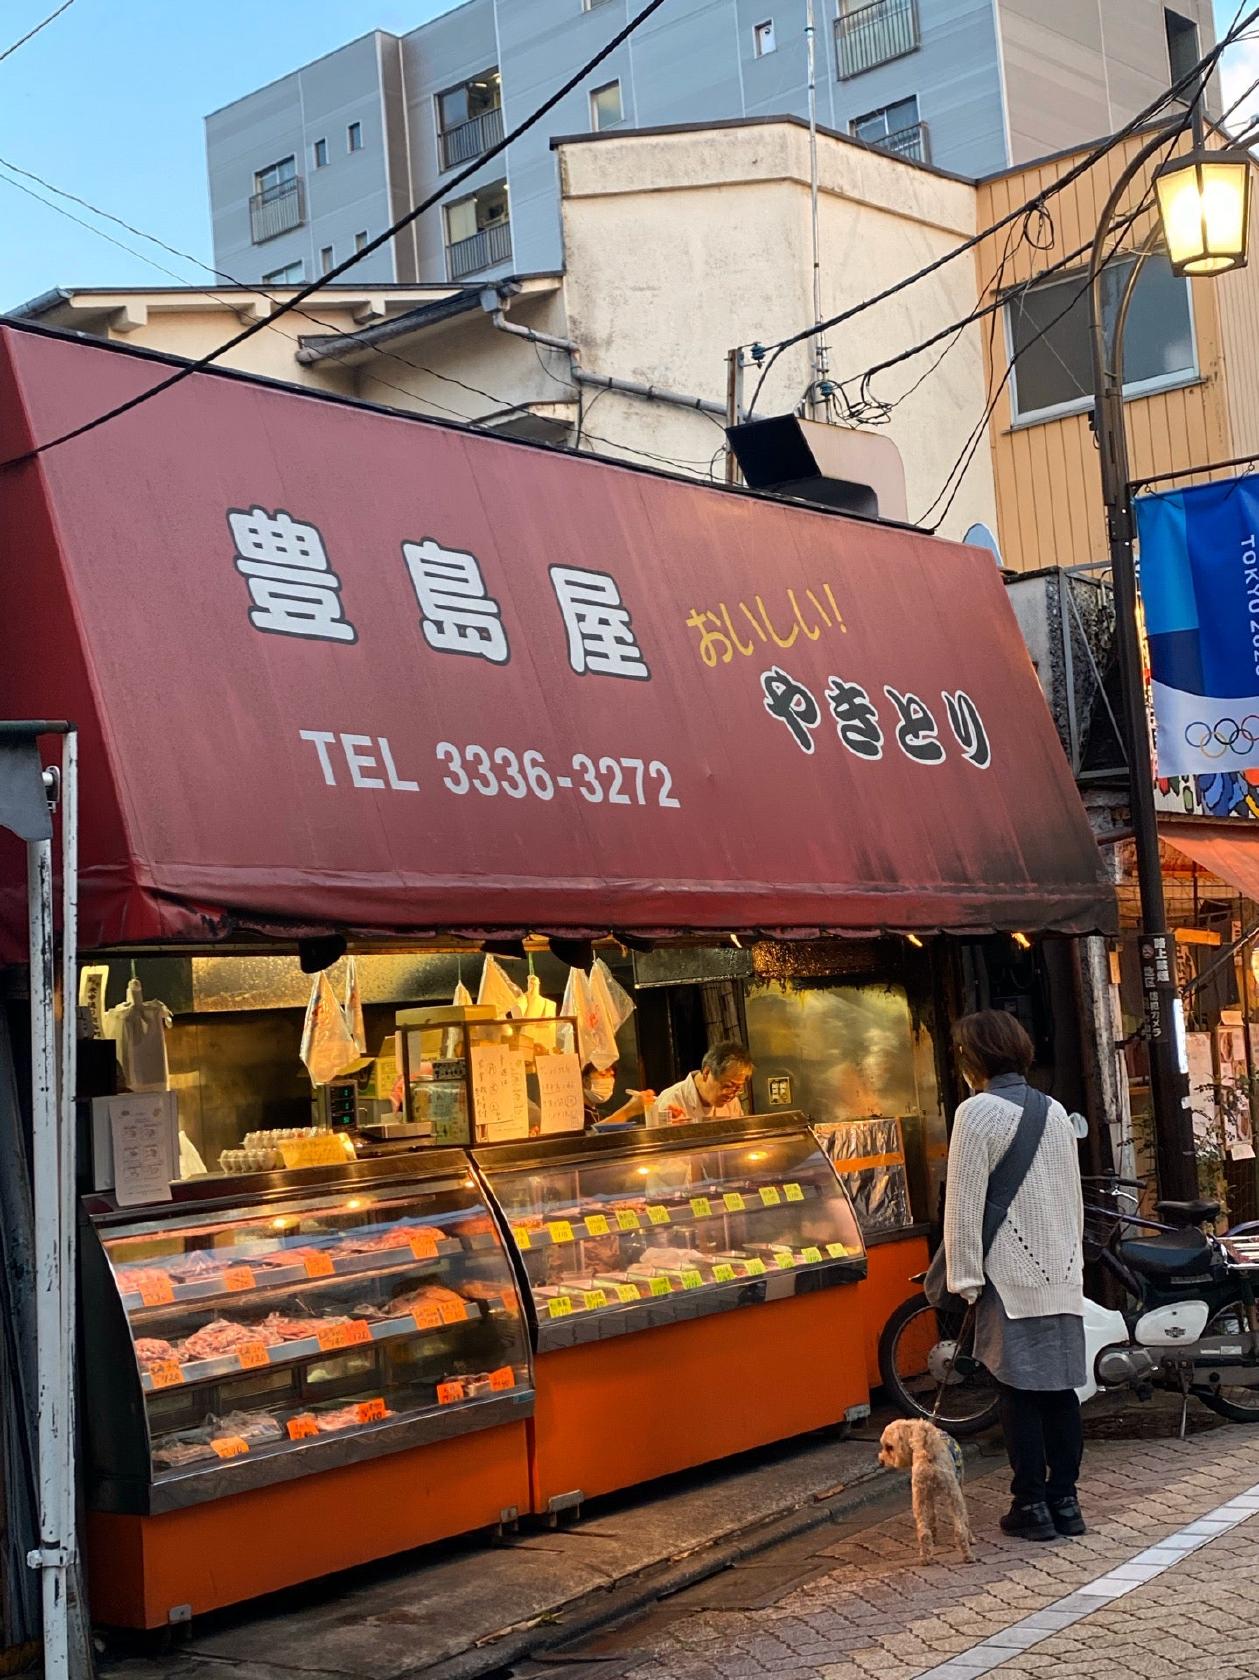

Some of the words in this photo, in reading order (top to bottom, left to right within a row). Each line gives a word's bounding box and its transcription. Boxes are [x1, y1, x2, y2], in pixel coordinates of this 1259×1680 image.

[227, 505, 652, 682] 豊島屋
[1241, 534, 1259, 613] TOKYO
[686, 583, 847, 667] おいしい!
[760, 665, 991, 769] やきとり
[299, 730, 420, 791] TEL
[435, 741, 681, 808] 3336-3272
